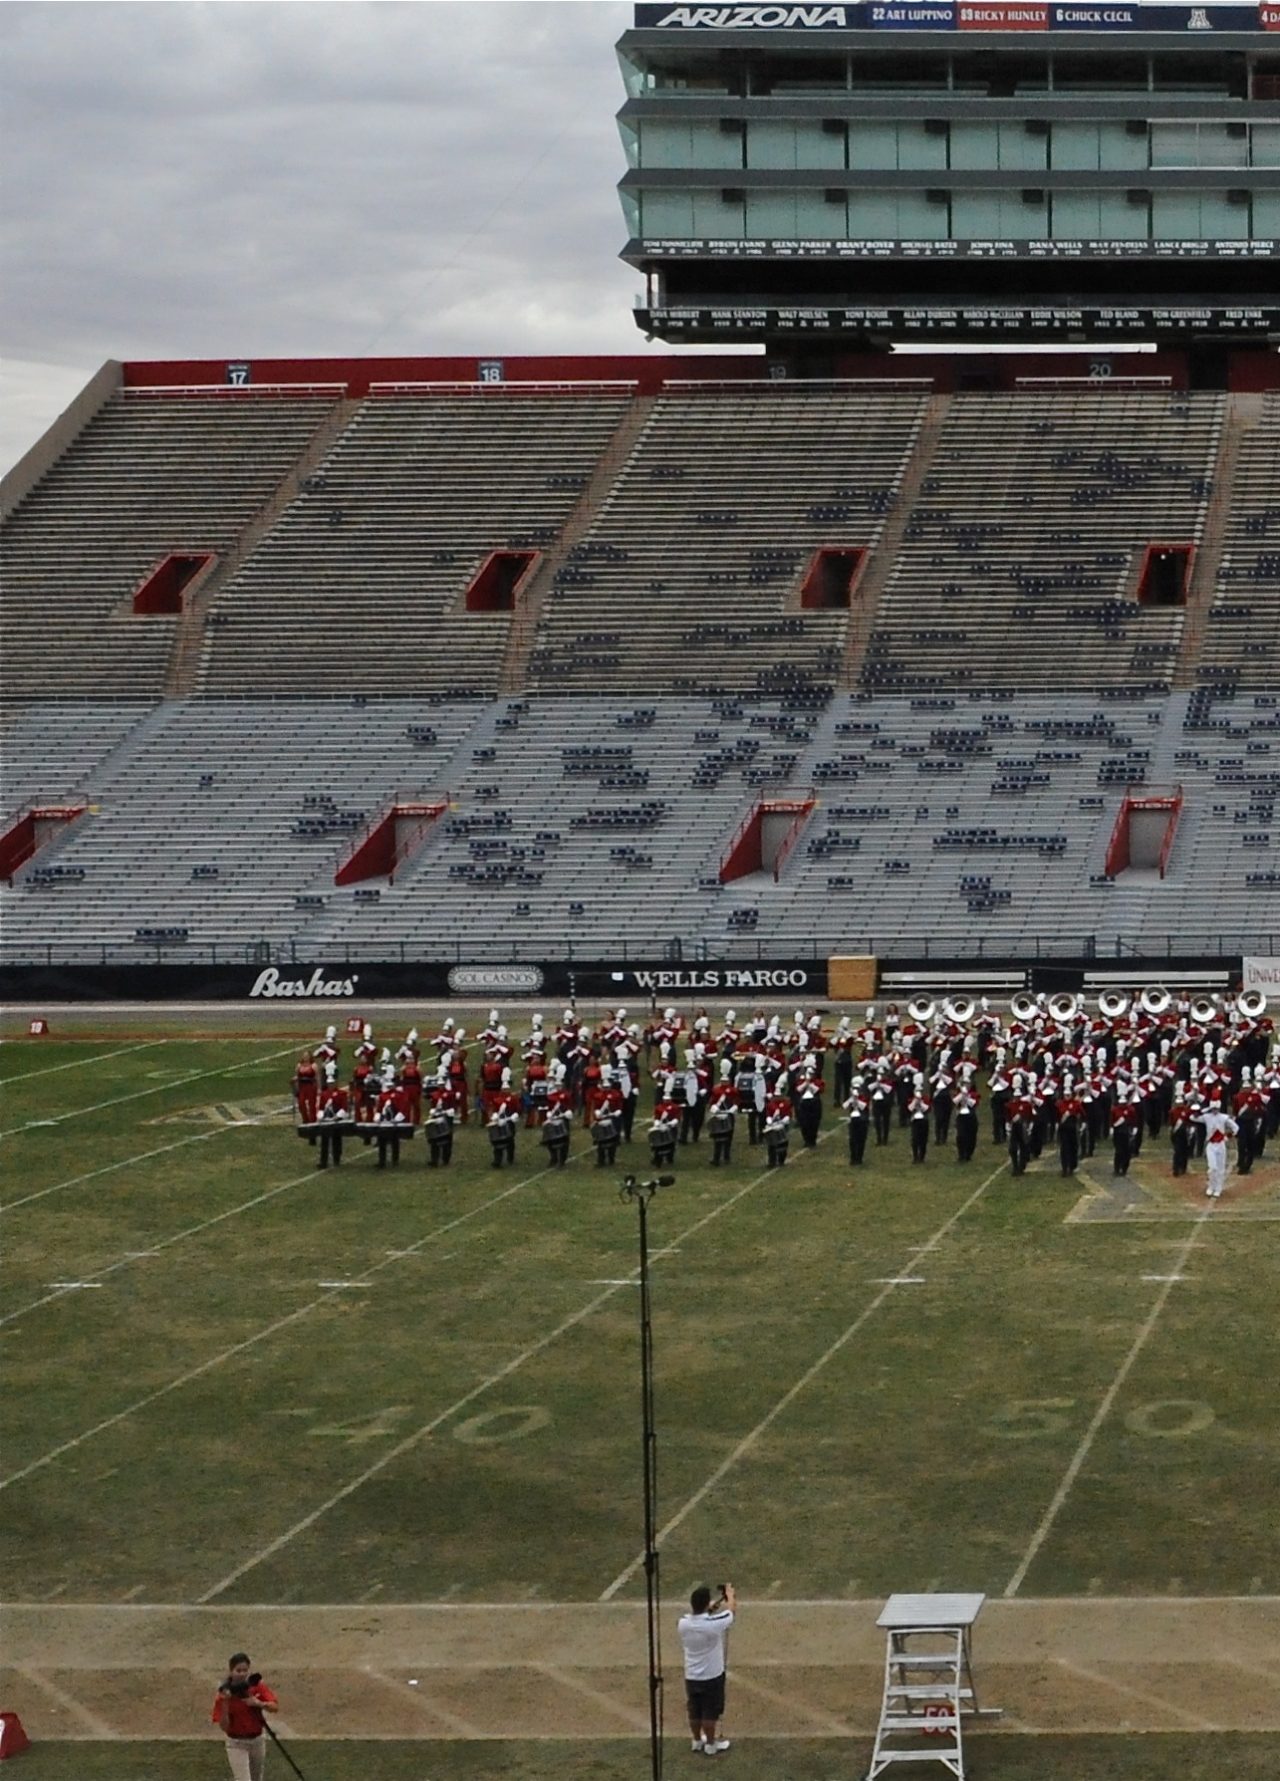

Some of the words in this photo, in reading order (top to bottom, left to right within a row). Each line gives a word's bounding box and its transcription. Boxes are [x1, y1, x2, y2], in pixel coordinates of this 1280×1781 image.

[656, 7, 846, 28] ARIZONA
[873, 8, 885, 20] 22
[886, 10, 905, 21] ART
[908, 10, 953, 21] LUPPINO
[974, 10, 1005, 21] RICKY
[1007, 10, 1046, 21] HUNLEY
[1065, 11, 1100, 21] CHUCK
[1103, 11, 1133, 21] CECIL
[1261, 10, 1268, 21] 4
[482, 368, 500, 382] 18
[1090, 363, 1111, 377] 20
[230, 371, 247, 384] 17
[250, 968, 359, 997] Bashas'
[458, 973, 476, 983] SOL
[483, 973, 534, 983] CASINOS
[633, 970, 719, 988] WELLS
[724, 970, 808, 987] FARGO
